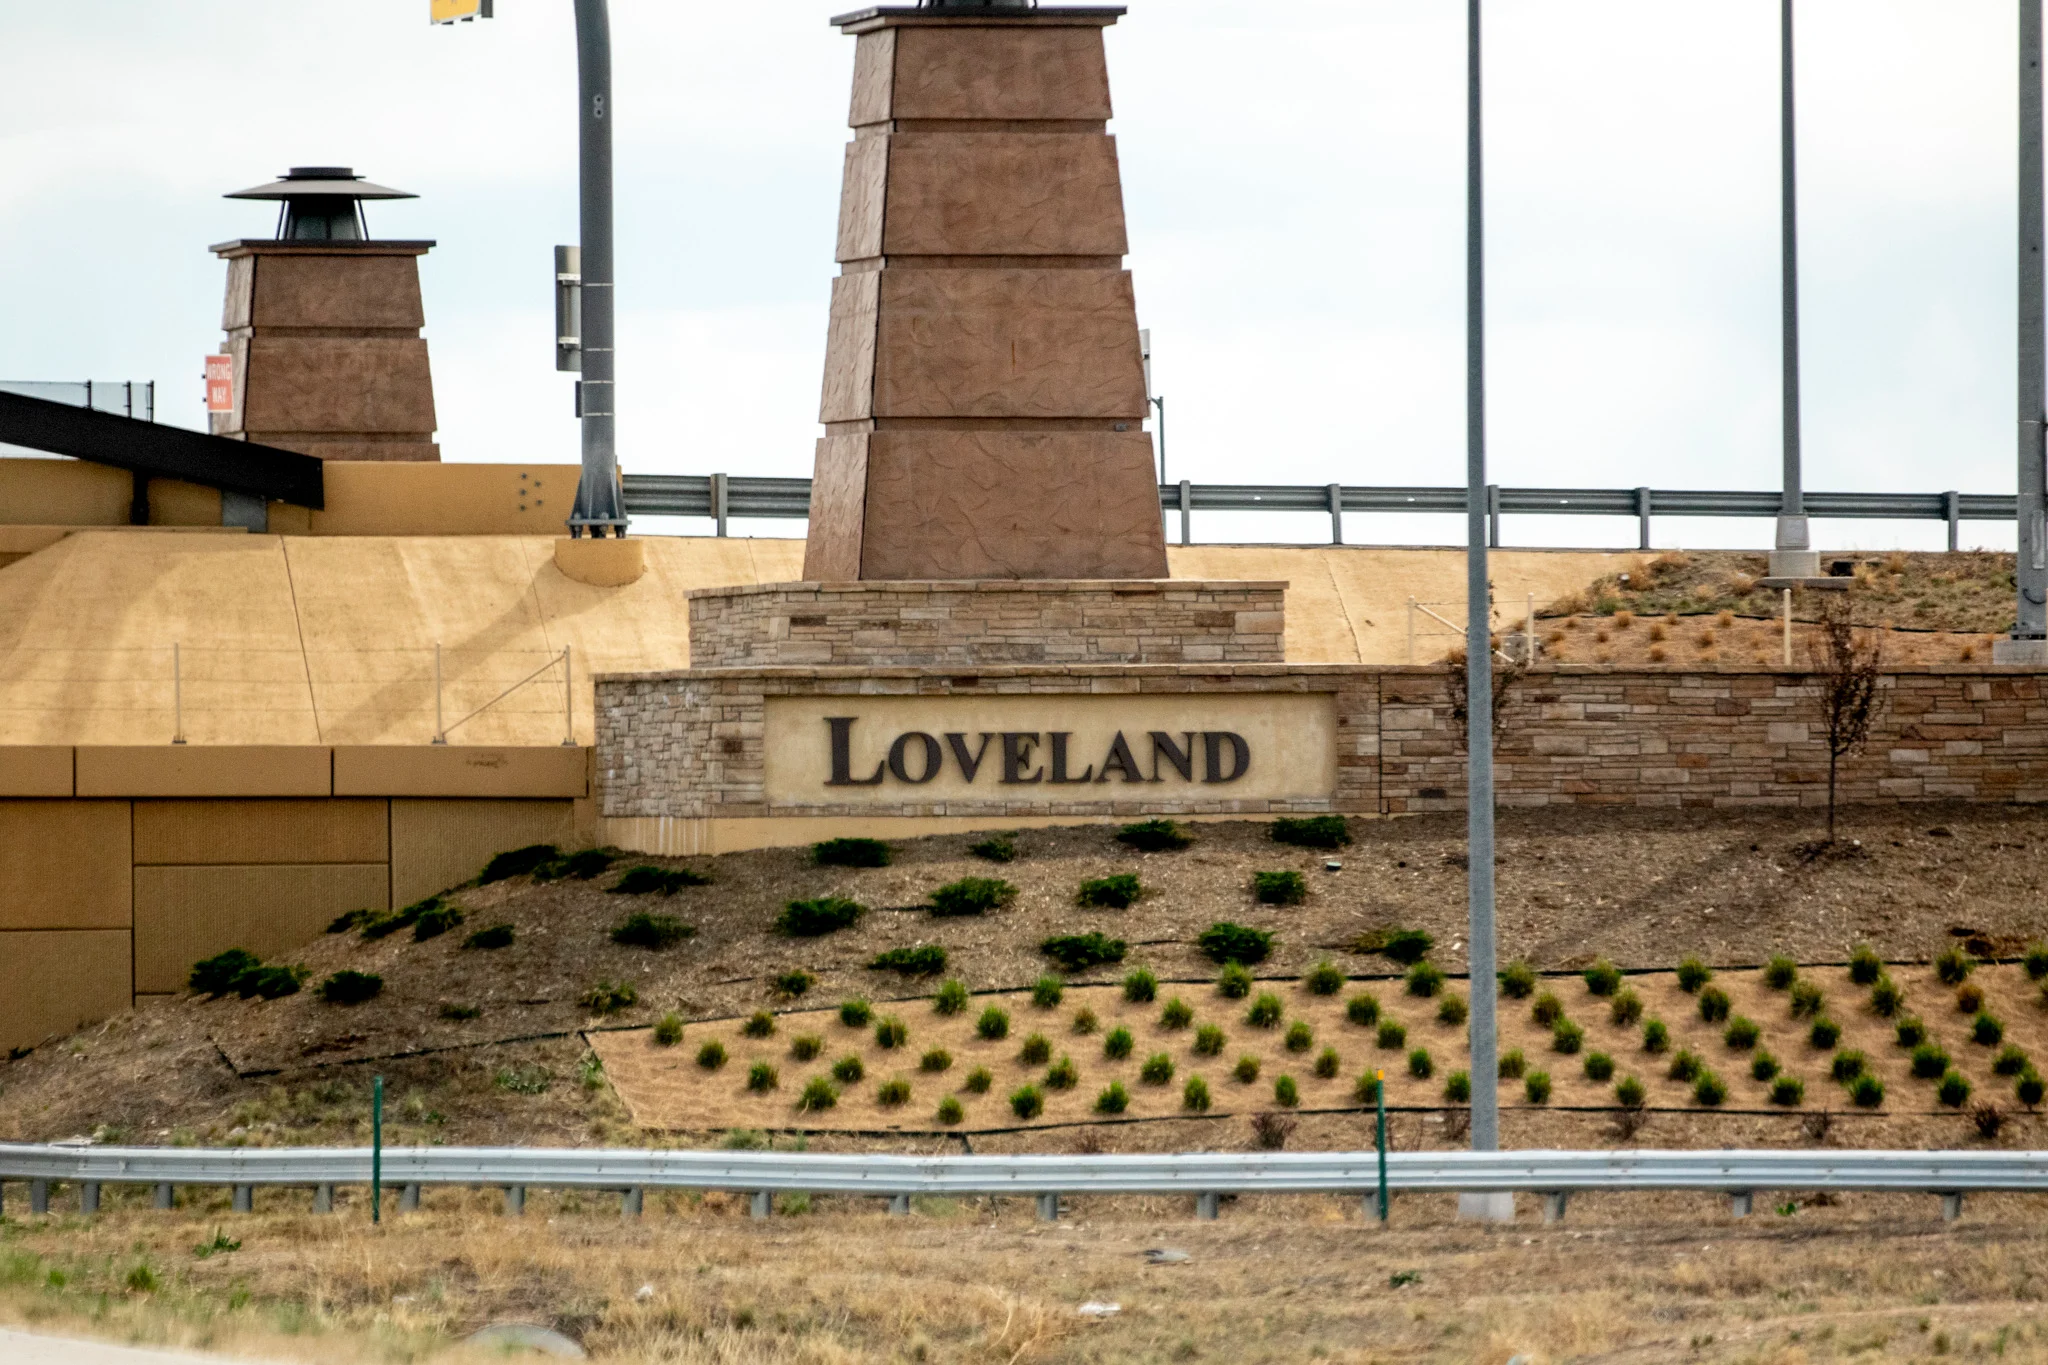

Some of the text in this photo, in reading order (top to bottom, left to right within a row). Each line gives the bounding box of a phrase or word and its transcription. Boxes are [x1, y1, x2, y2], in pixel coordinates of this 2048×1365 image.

[206, 363, 231, 380] WRONG
[212, 386, 226, 404] WAY
[823, 716, 1251, 786] LOVELAND
